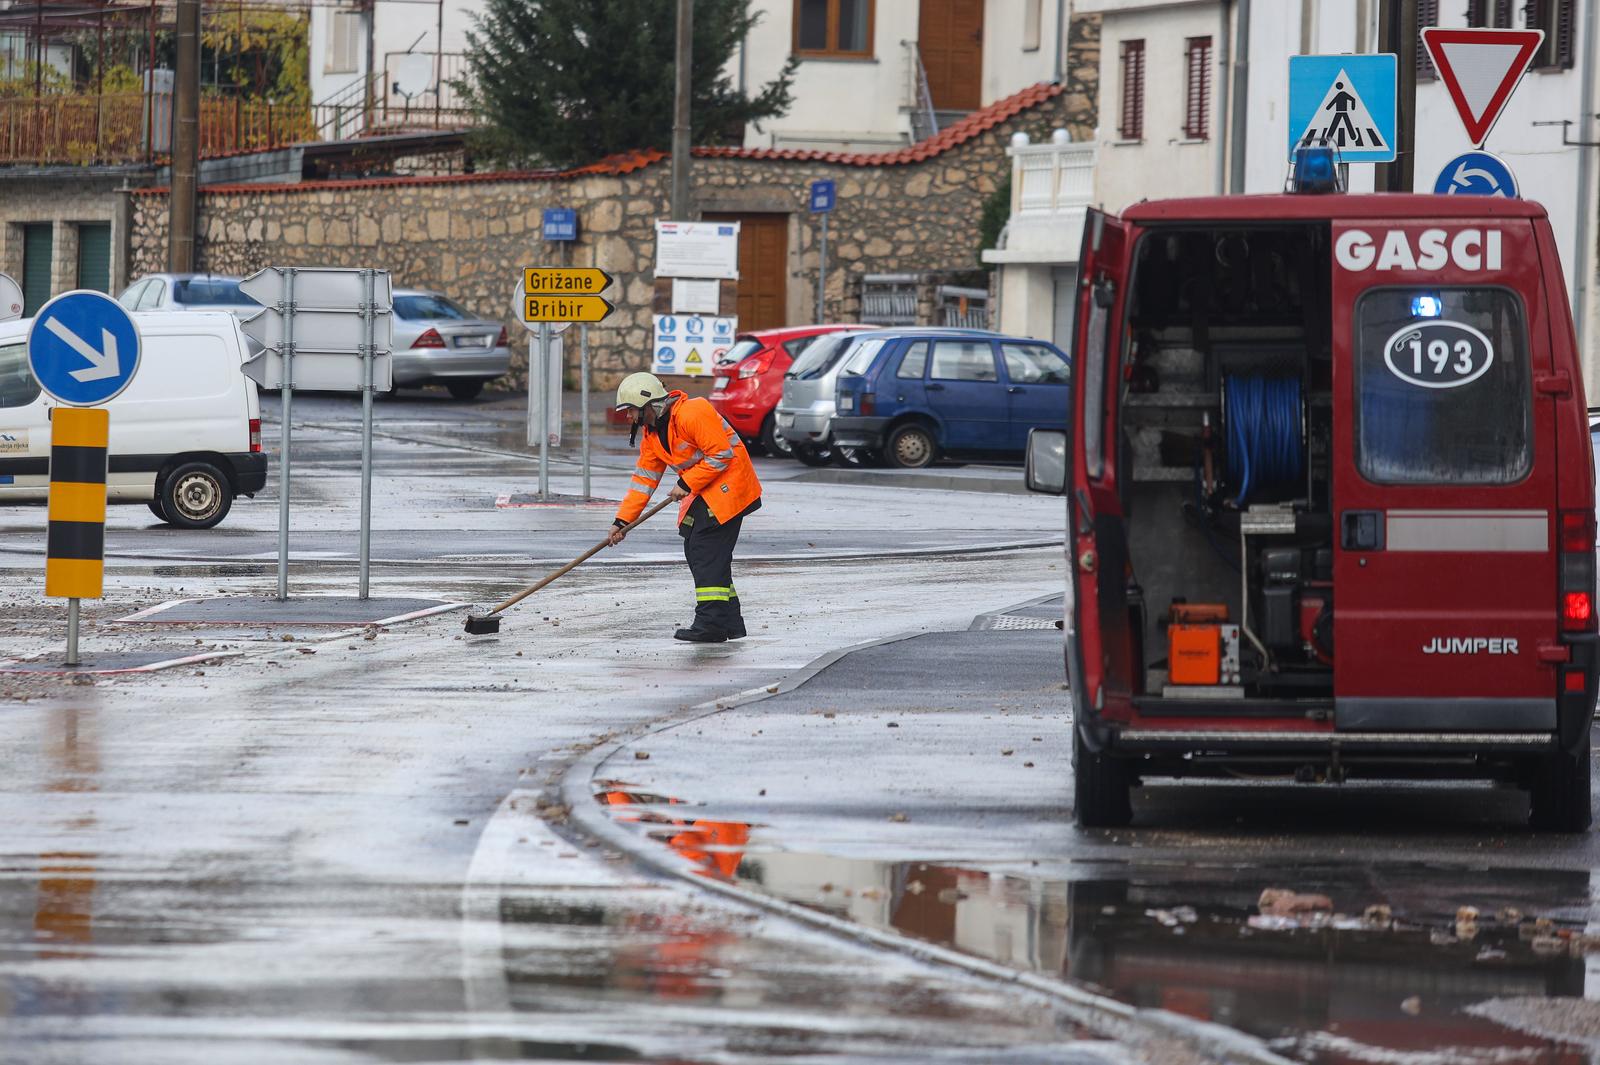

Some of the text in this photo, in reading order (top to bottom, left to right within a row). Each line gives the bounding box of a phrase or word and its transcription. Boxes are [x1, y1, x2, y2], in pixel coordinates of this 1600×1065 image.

[1335, 229, 1502, 271] GASCI
[530, 272, 593, 290] Grižane
[529, 300, 584, 317] Bribir
[1409, 339, 1473, 375] 193
[1422, 637, 1519, 655] JUMPER
